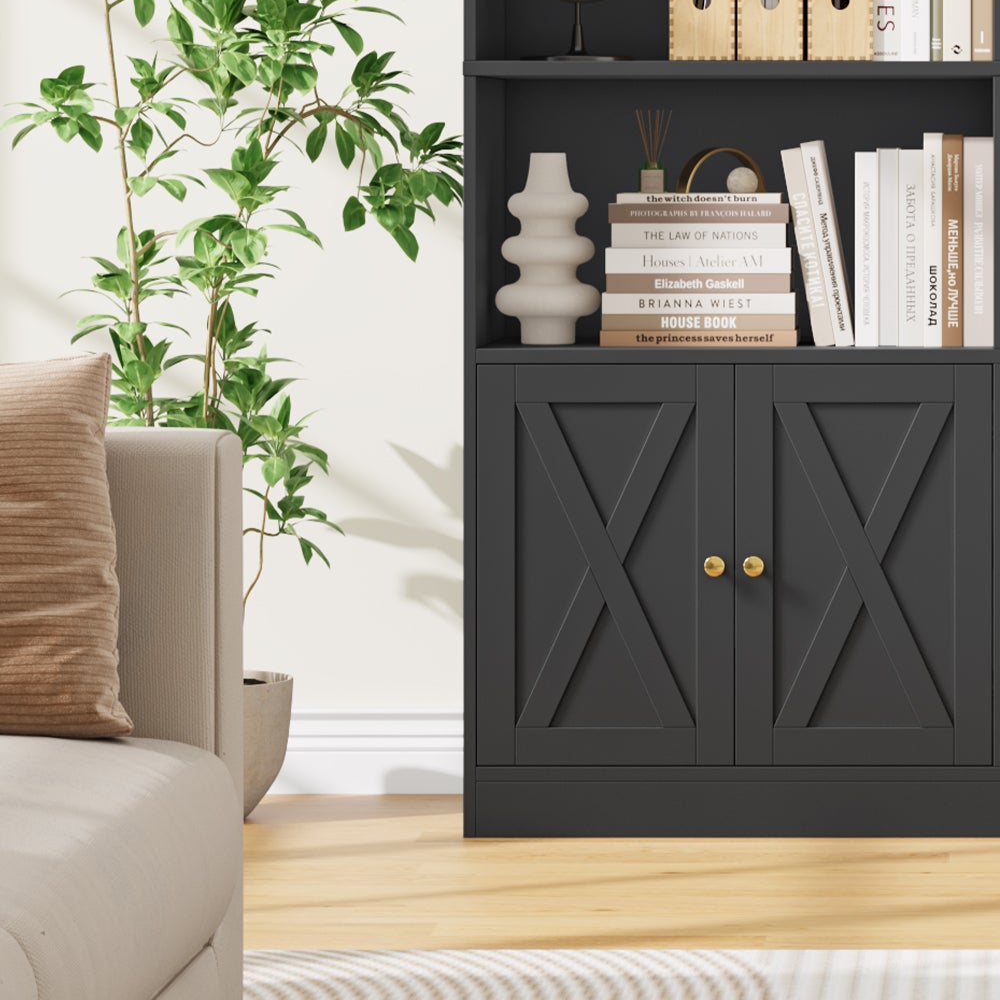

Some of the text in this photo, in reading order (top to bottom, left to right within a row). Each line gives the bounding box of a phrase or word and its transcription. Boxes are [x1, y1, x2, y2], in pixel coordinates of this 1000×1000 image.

[643, 230, 760, 241] THE LAW OF NATIONS
[791, 192, 825, 309] СПАСИТЕ КОТИКА!
[905, 183, 916, 323] ЗАБОТА О ПРЕДАННЫХ
[643, 254, 764, 268] Houses Atelier AM
[820, 213, 847, 332] Метод управления проектами
[654, 278, 745, 289] Elizabeth Gaskell
[927, 264, 938, 327] ШОКОЛАД
[638, 298, 753, 309] BRIANNA WIEST
[660, 316, 738, 329] HOUSE BOOK
